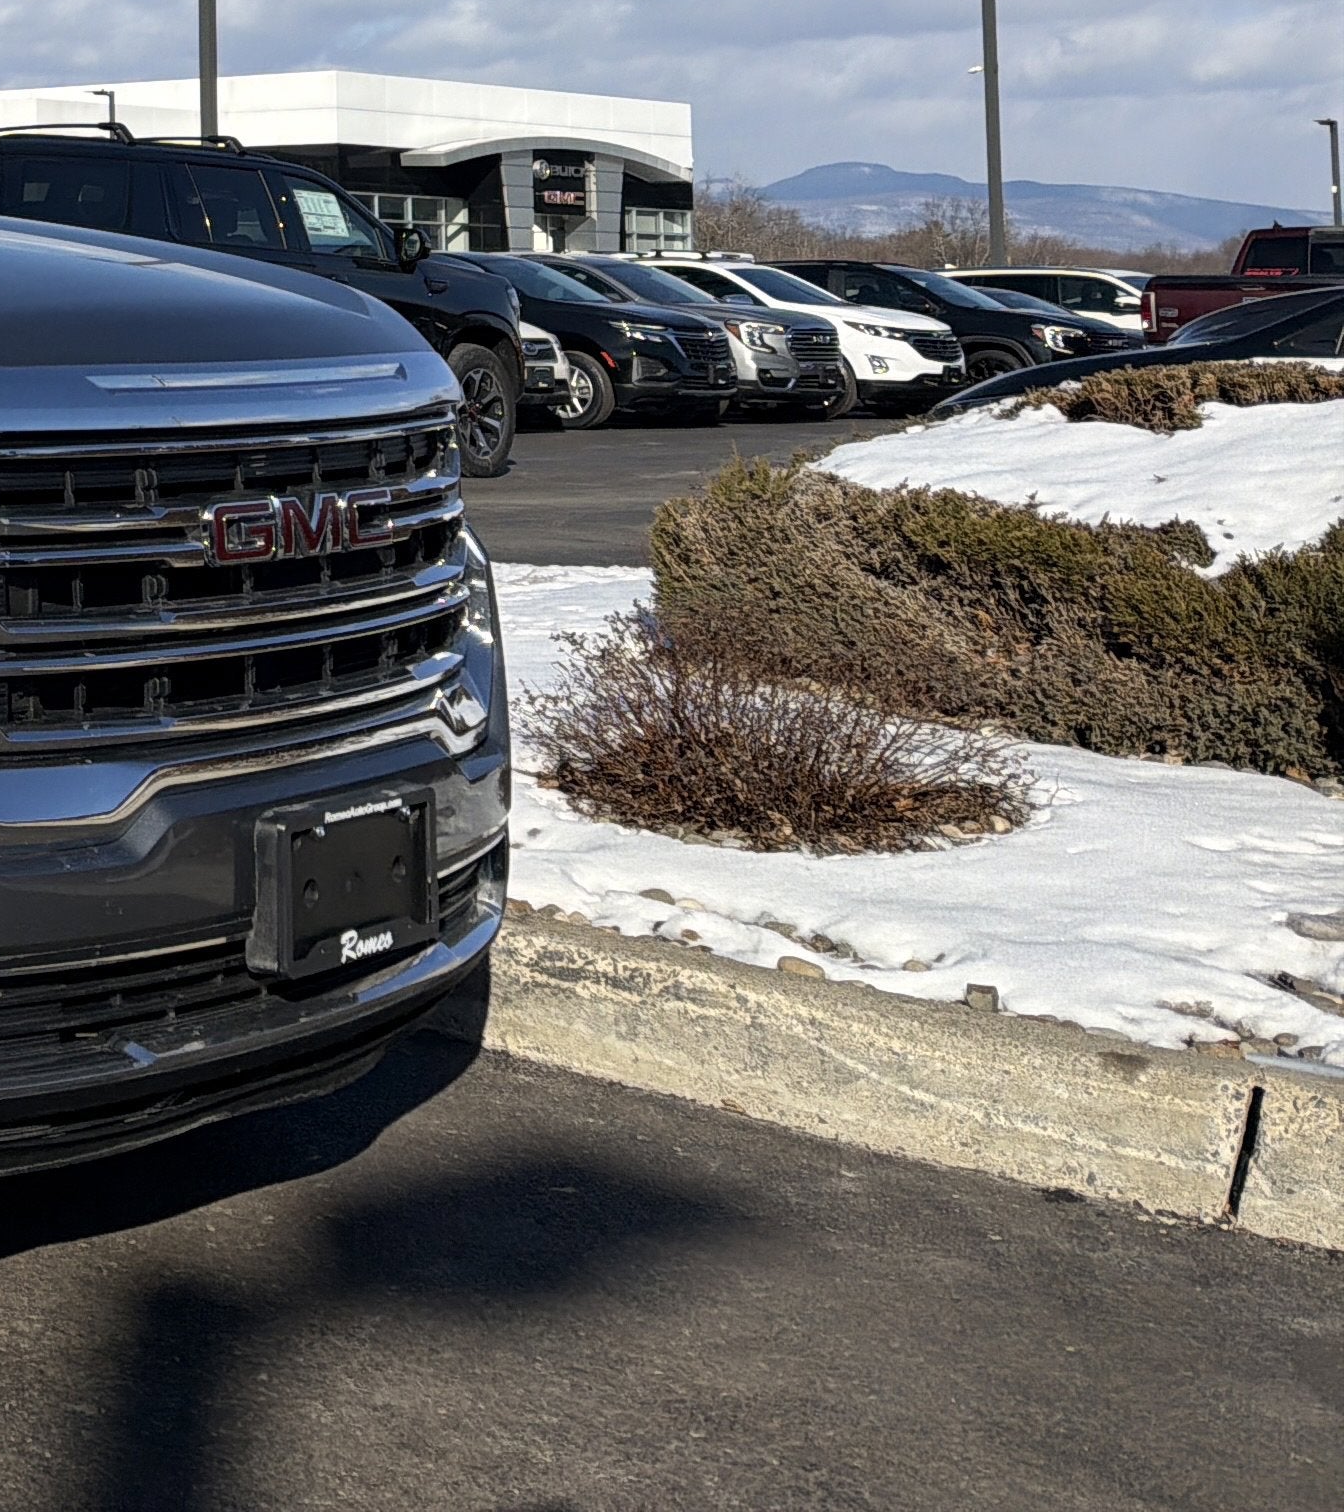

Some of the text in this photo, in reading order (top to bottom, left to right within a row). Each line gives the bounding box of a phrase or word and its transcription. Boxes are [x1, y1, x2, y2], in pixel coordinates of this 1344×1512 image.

[543, 190, 585, 206] GMC
[207, 487, 394, 565] GMC
[340, 929, 394, 964] Romeo
